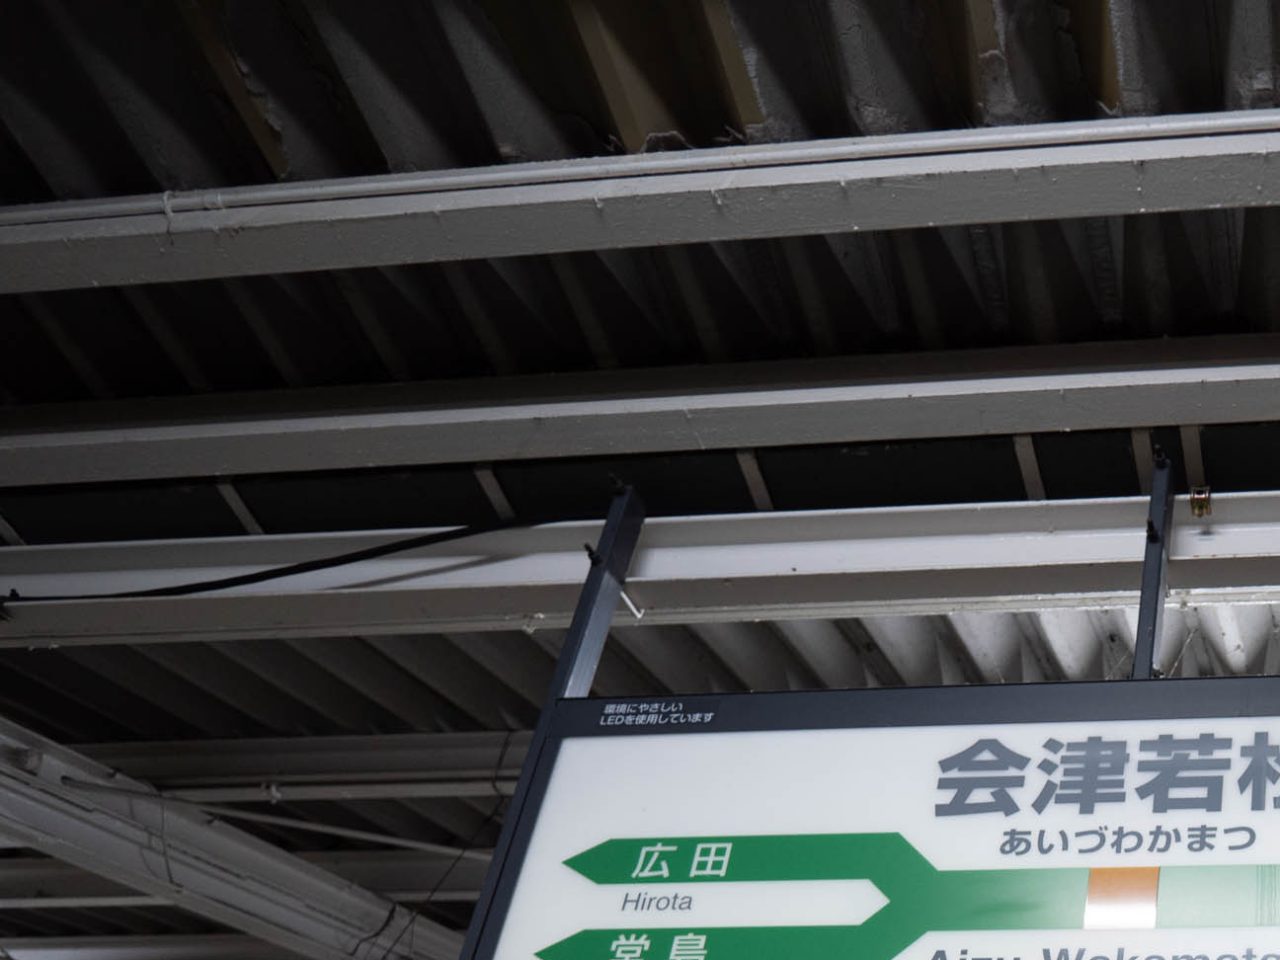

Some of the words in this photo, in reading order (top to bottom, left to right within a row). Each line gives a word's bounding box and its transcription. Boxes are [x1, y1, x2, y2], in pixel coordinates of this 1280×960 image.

[604, 702, 683, 714] 環境にやさしい
[600, 713, 715, 725] LEDを使用しています
[1000, 824, 1257, 856] あいづわかまつ
[631, 842, 733, 878] 広田
[621, 892, 693, 911] Hirota
